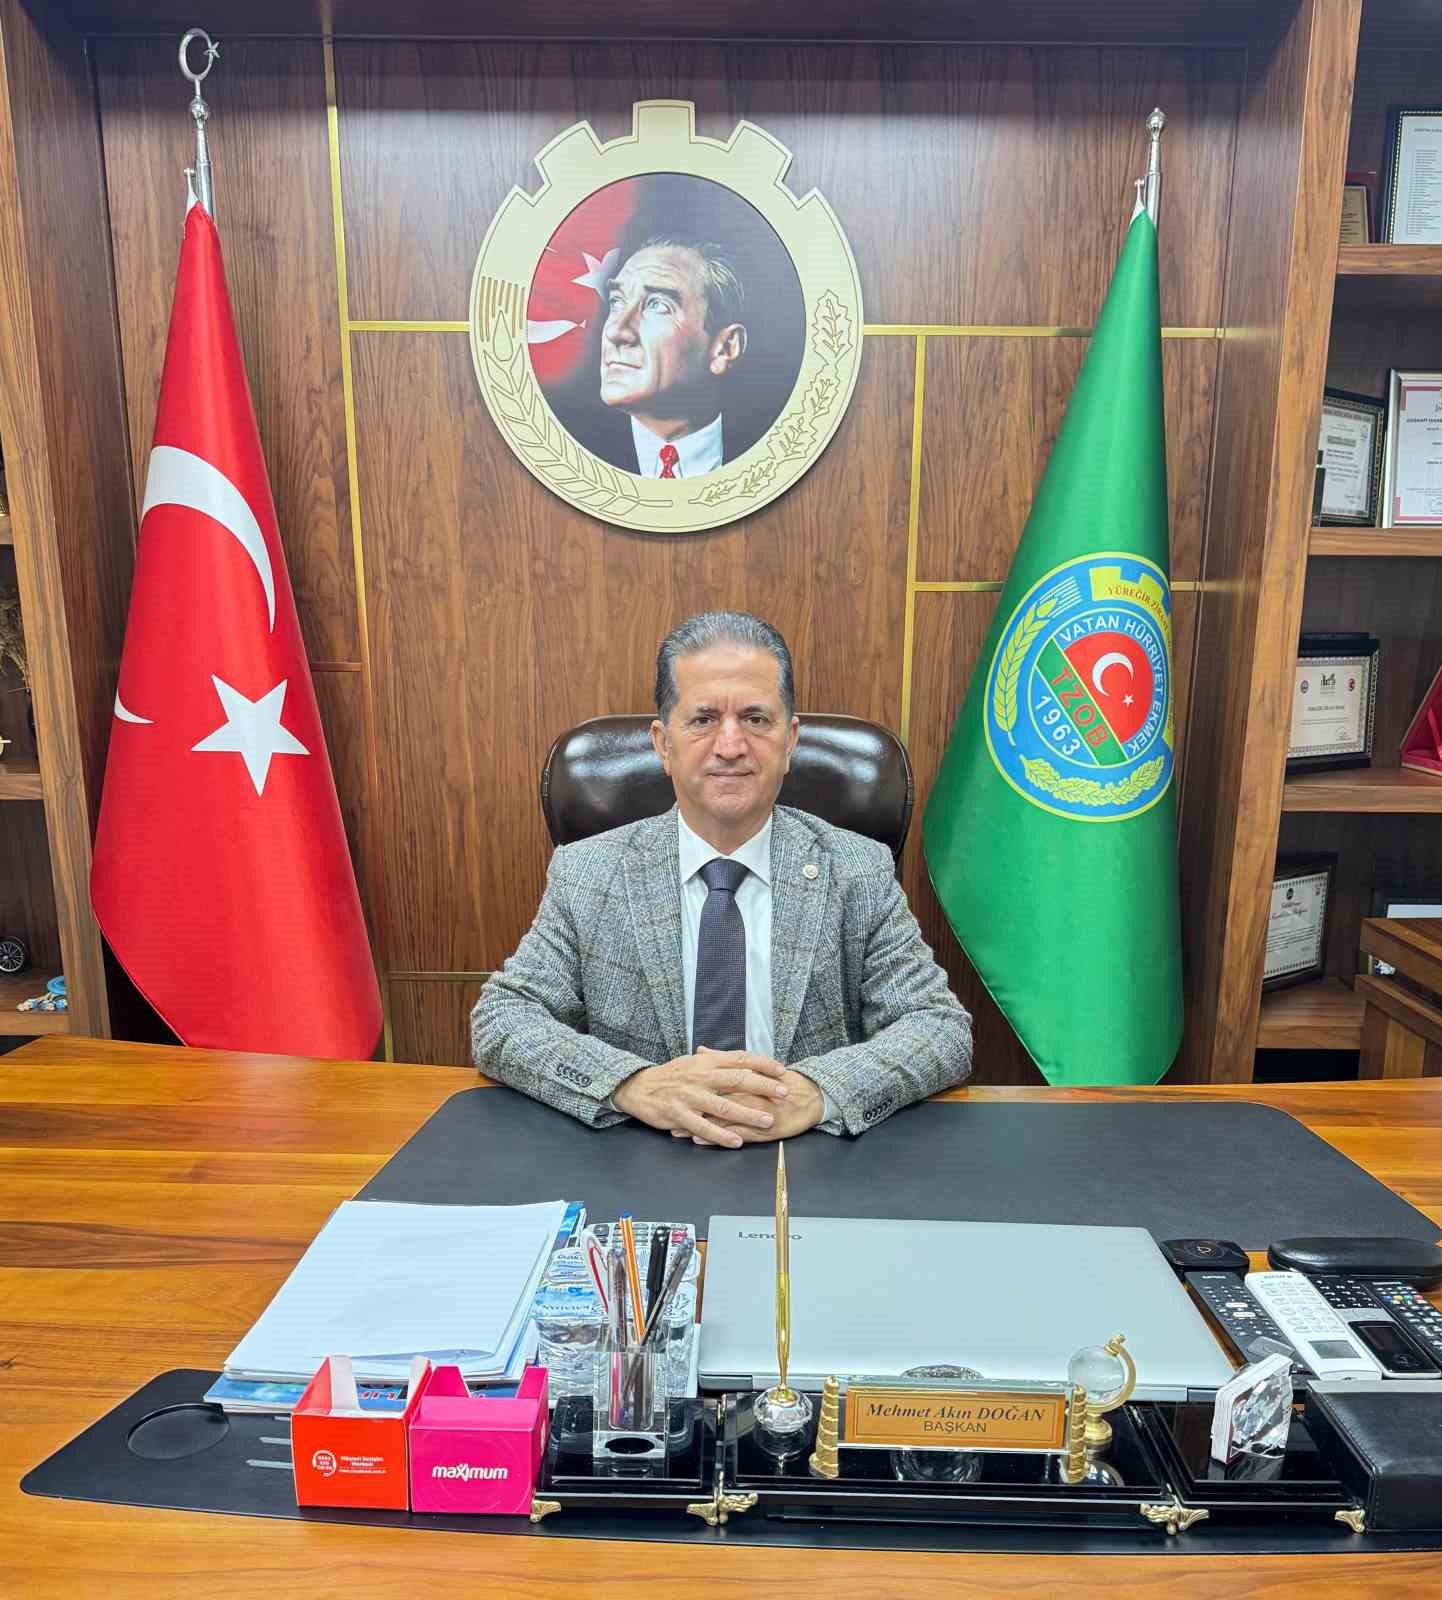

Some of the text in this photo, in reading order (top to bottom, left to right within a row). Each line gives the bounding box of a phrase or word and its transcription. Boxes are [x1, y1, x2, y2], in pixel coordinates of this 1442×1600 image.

[1051, 666, 1109, 747] TZOB
[1060, 615, 1164, 755] VATAN HÜRRİYET EKMEK
[1035, 695, 1081, 755] 1963
[867, 1403, 1046, 1421] Mehmet Akın DOĞAN
[923, 1420, 987, 1434] BAŞKAN
